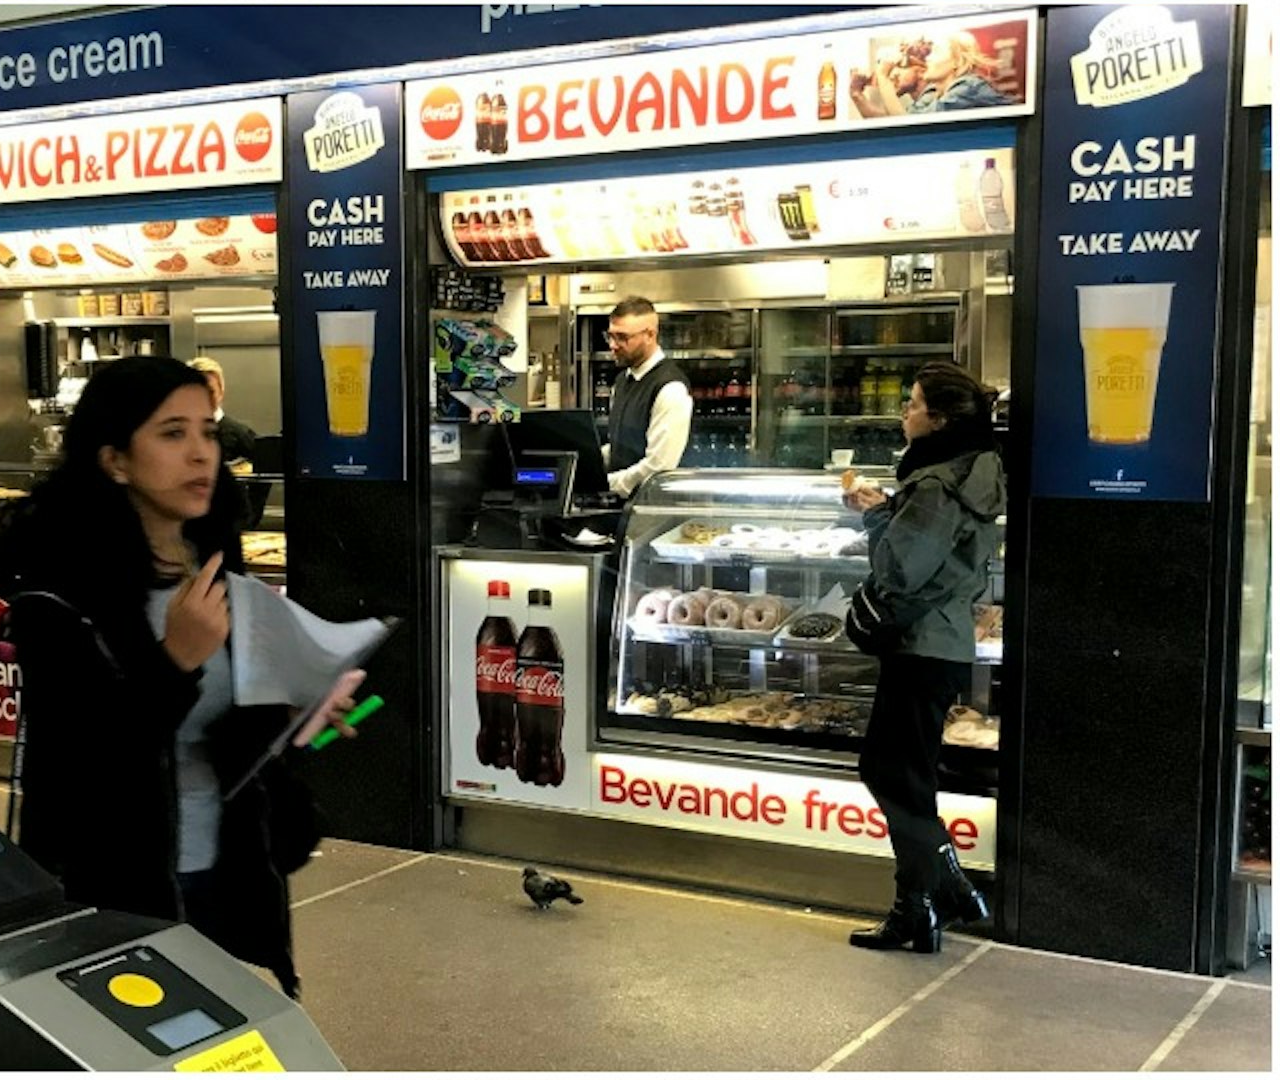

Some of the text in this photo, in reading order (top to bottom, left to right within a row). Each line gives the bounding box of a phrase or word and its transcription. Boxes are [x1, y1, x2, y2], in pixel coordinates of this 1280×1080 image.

[47, 30, 163, 83] cream
[1085, 36, 1188, 95] PORETTI
[516, 56, 797, 144] BEVANDE
[313, 120, 376, 163] PORETTI
[1070, 134, 1196, 177] CASH
[1069, 175, 1193, 203] PAY HERE
[307, 195, 384, 228] CASH
[308, 227, 384, 247] PAY HERE
[1058, 229, 1201, 255] TAKE AWAY
[303, 269, 390, 289] TAKE AWAY
[599, 765, 979, 850] Bevande frese
